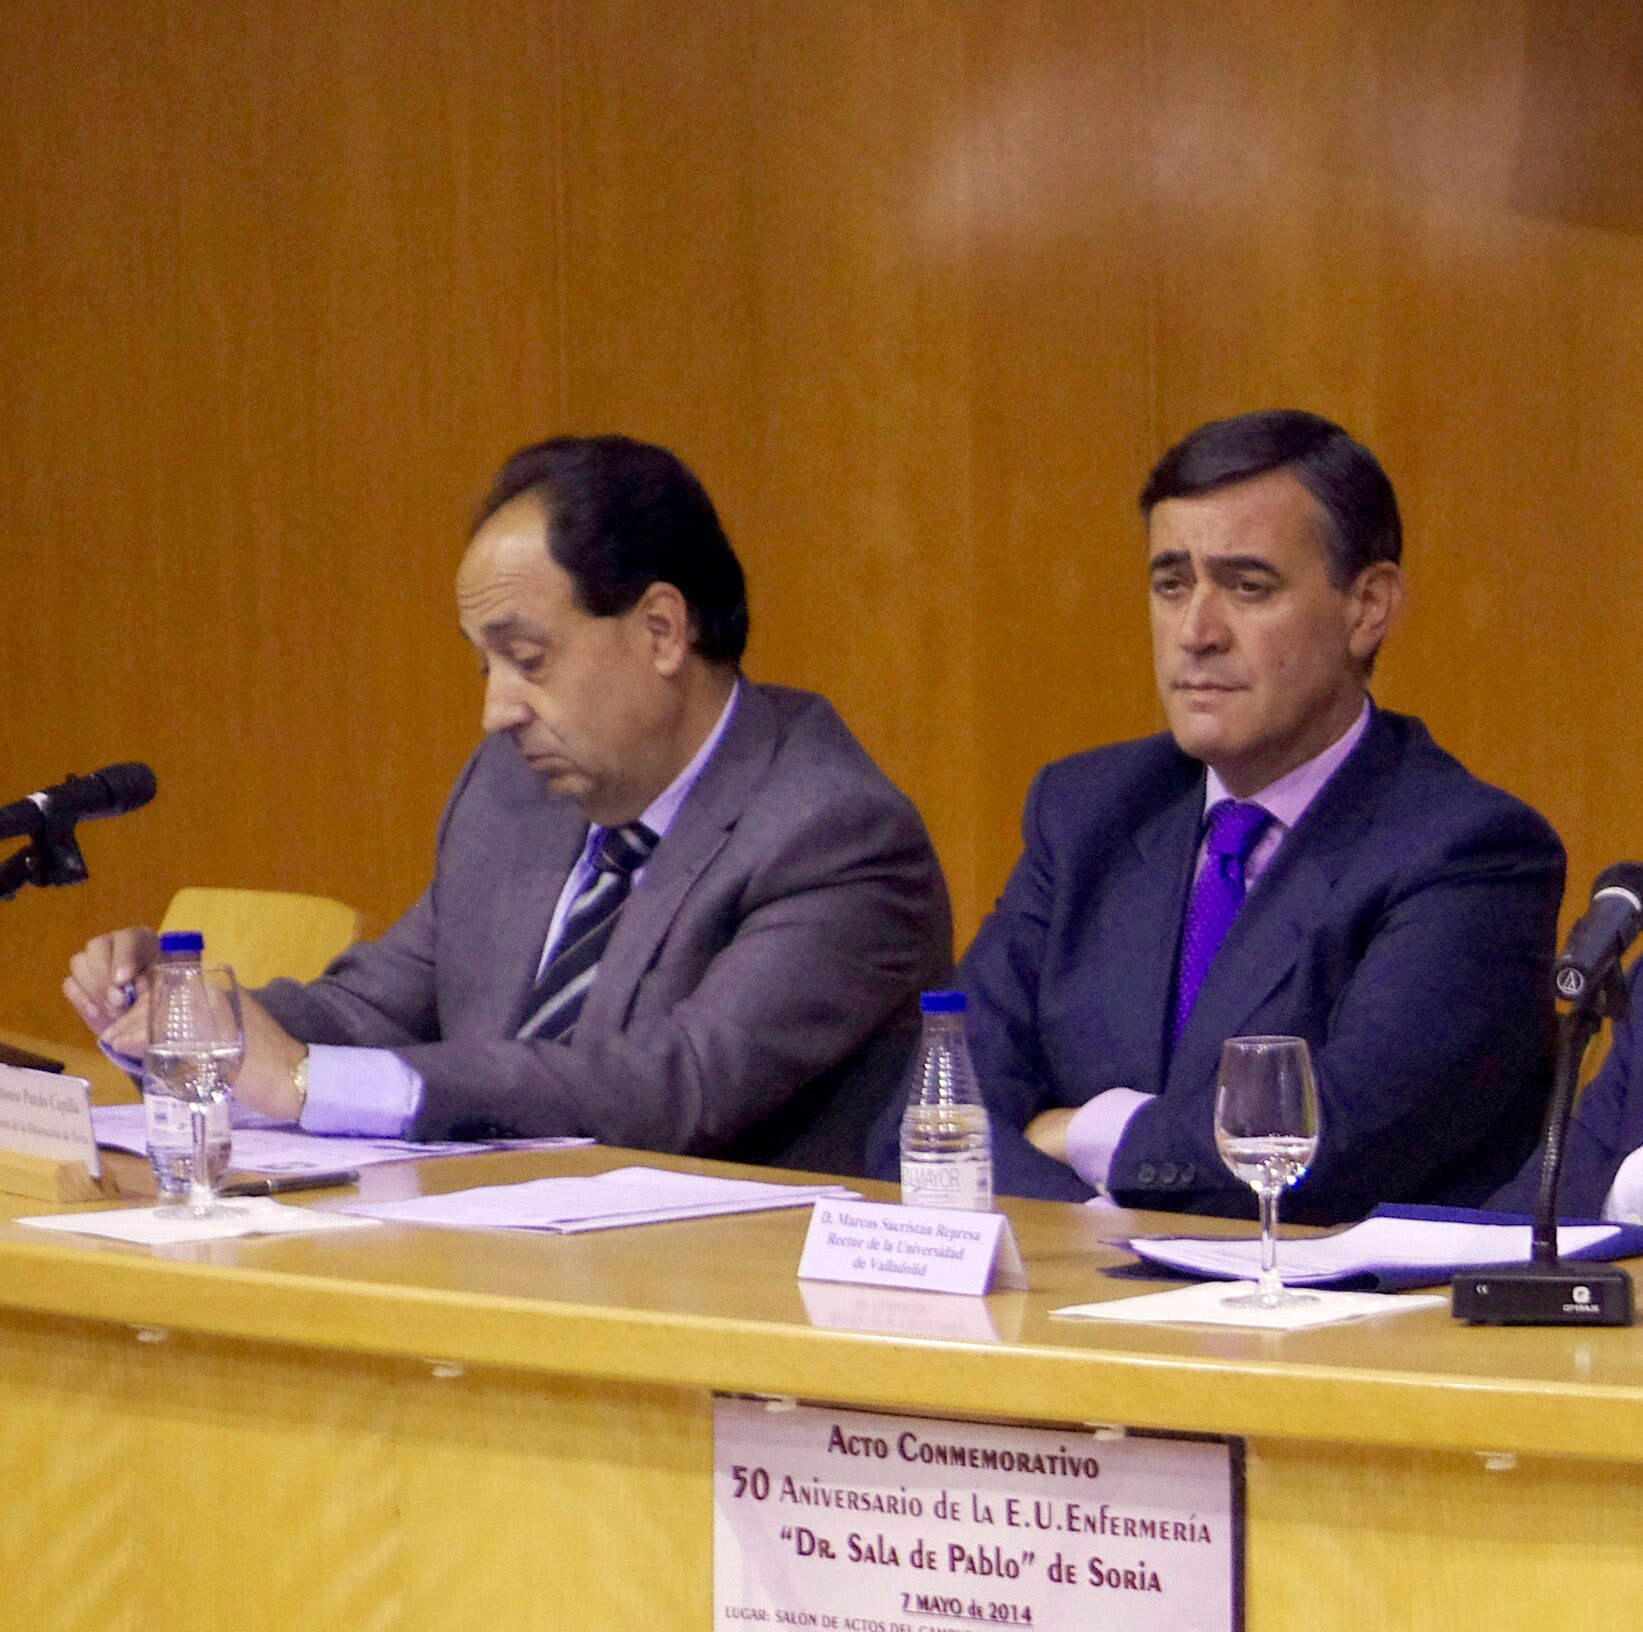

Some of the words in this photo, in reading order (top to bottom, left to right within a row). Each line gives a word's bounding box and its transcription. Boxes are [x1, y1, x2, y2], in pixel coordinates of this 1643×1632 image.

[821, 1210, 832, 1223] D.
[839, 1213, 877, 1229] Marcos
[935, 1224, 980, 1241] Represa
[827, 1232, 864, 1248] Rector
[867, 1236, 880, 1249] de
[883, 1238, 892, 1251] la
[897, 1241, 964, 1260] Universidad
[853, 1256, 866, 1269] de
[870, 1259, 926, 1276] Valladolid
[731, 1464, 769, 1501] 50
[725, 1606, 770, 1624] LUGAR:
[821, 1614, 839, 1630] DE
[901, 1593, 910, 1611] 7
[915, 1594, 961, 1618] MAYO
[988, 1601, 1033, 1624] 2014
